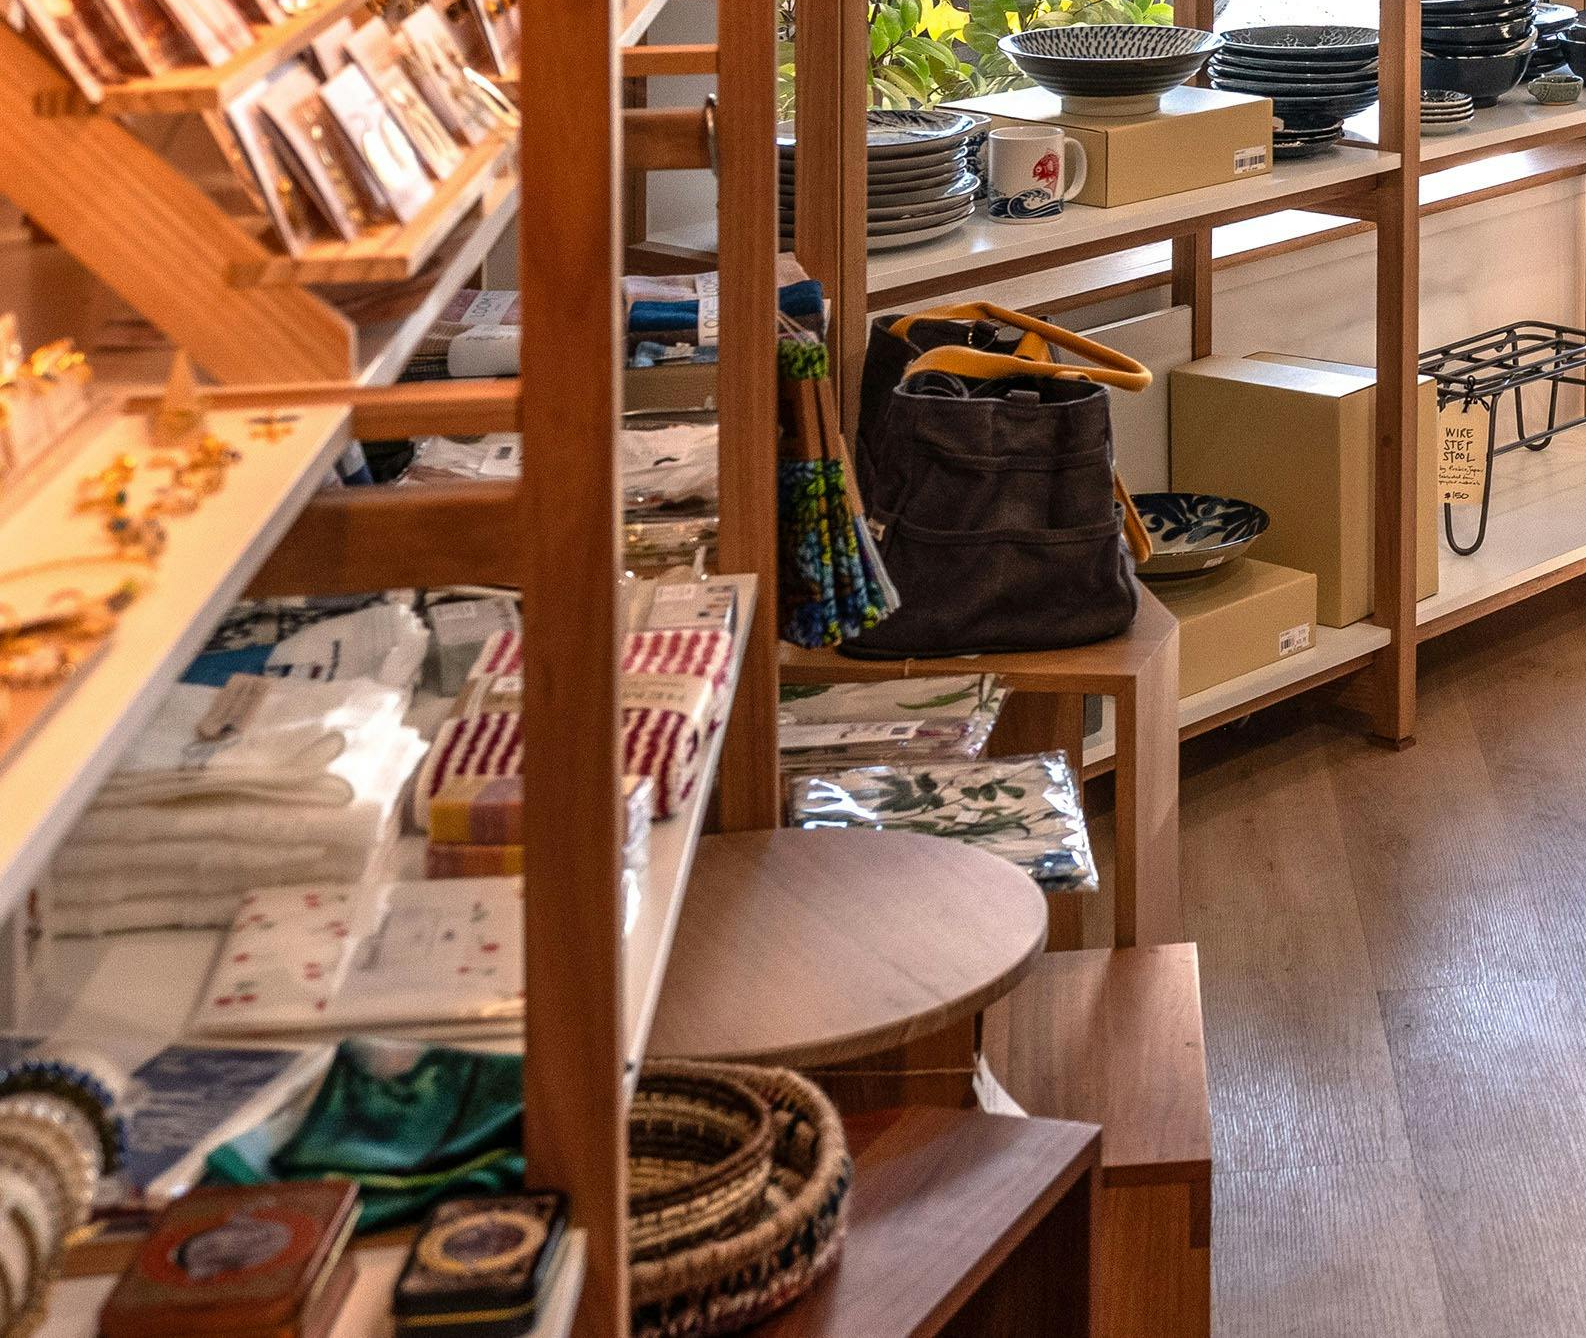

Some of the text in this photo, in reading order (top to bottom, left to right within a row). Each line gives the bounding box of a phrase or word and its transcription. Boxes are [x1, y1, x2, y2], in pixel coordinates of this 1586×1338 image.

[1445, 427, 1474, 438] WIRE
[1443, 439, 1473, 451] STEP
[1443, 451, 1475, 463] STOOL
